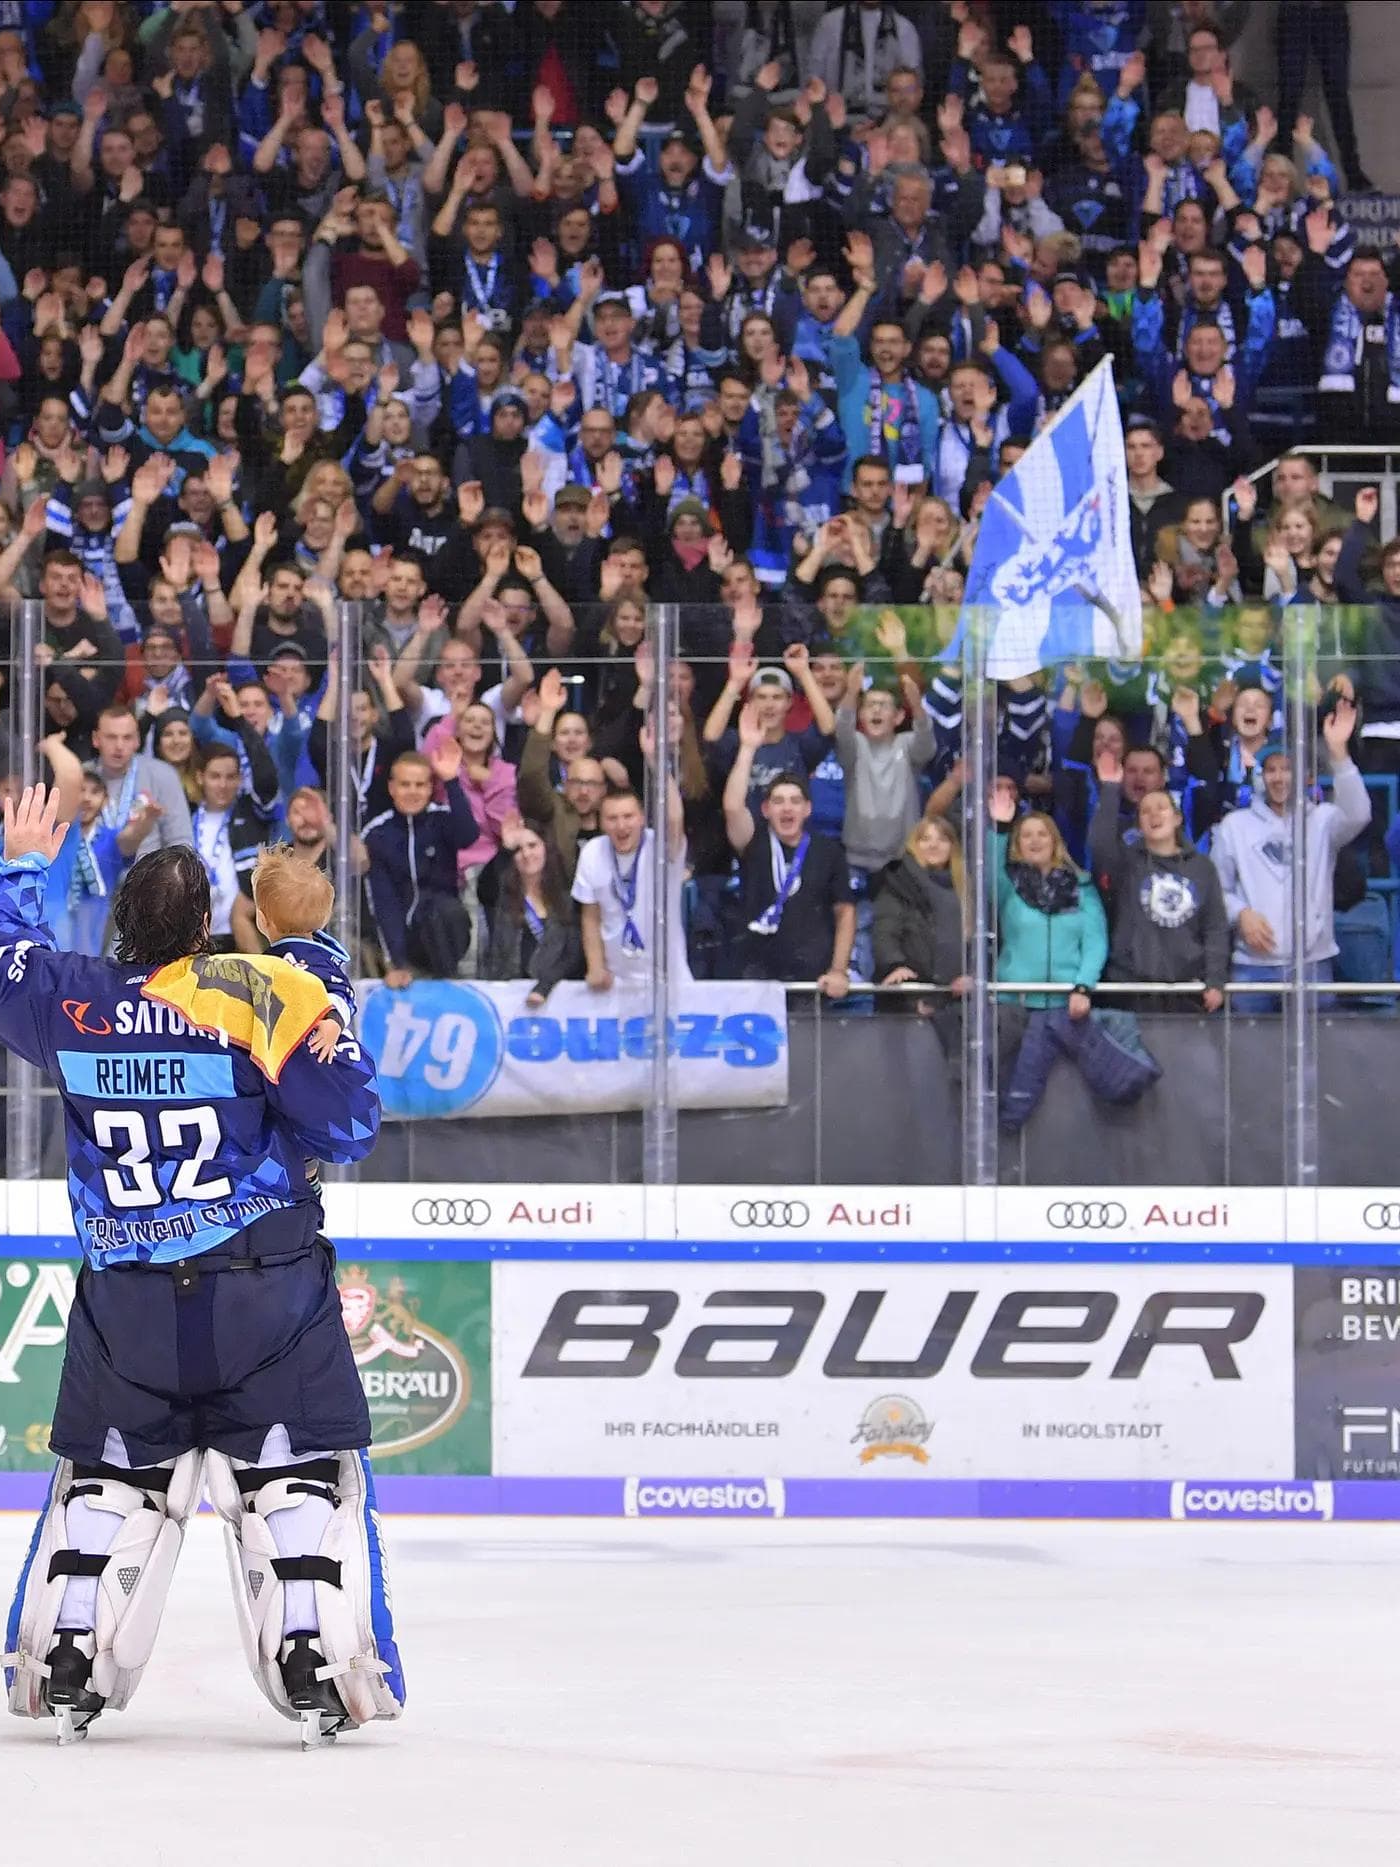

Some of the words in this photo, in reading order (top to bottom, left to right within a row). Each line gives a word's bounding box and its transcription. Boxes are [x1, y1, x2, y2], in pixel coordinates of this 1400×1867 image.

[379, 1004, 479, 1091] 64
[95, 1057, 187, 1096] REIMER
[90, 1105, 237, 1209] 32
[507, 1200, 594, 1225] Audi
[826, 1202, 912, 1227] Audi
[1143, 1203, 1230, 1228] Audi
[1341, 1278, 1400, 1305] BRI
[605, 1422, 634, 1437] IHR
[641, 1419, 780, 1438] FACHHÄNDLER
[1022, 1423, 1041, 1438] IN
[1046, 1423, 1164, 1439] INGOLSTADT
[638, 1482, 766, 1510] covestro
[1183, 1486, 1312, 1514] covestro
